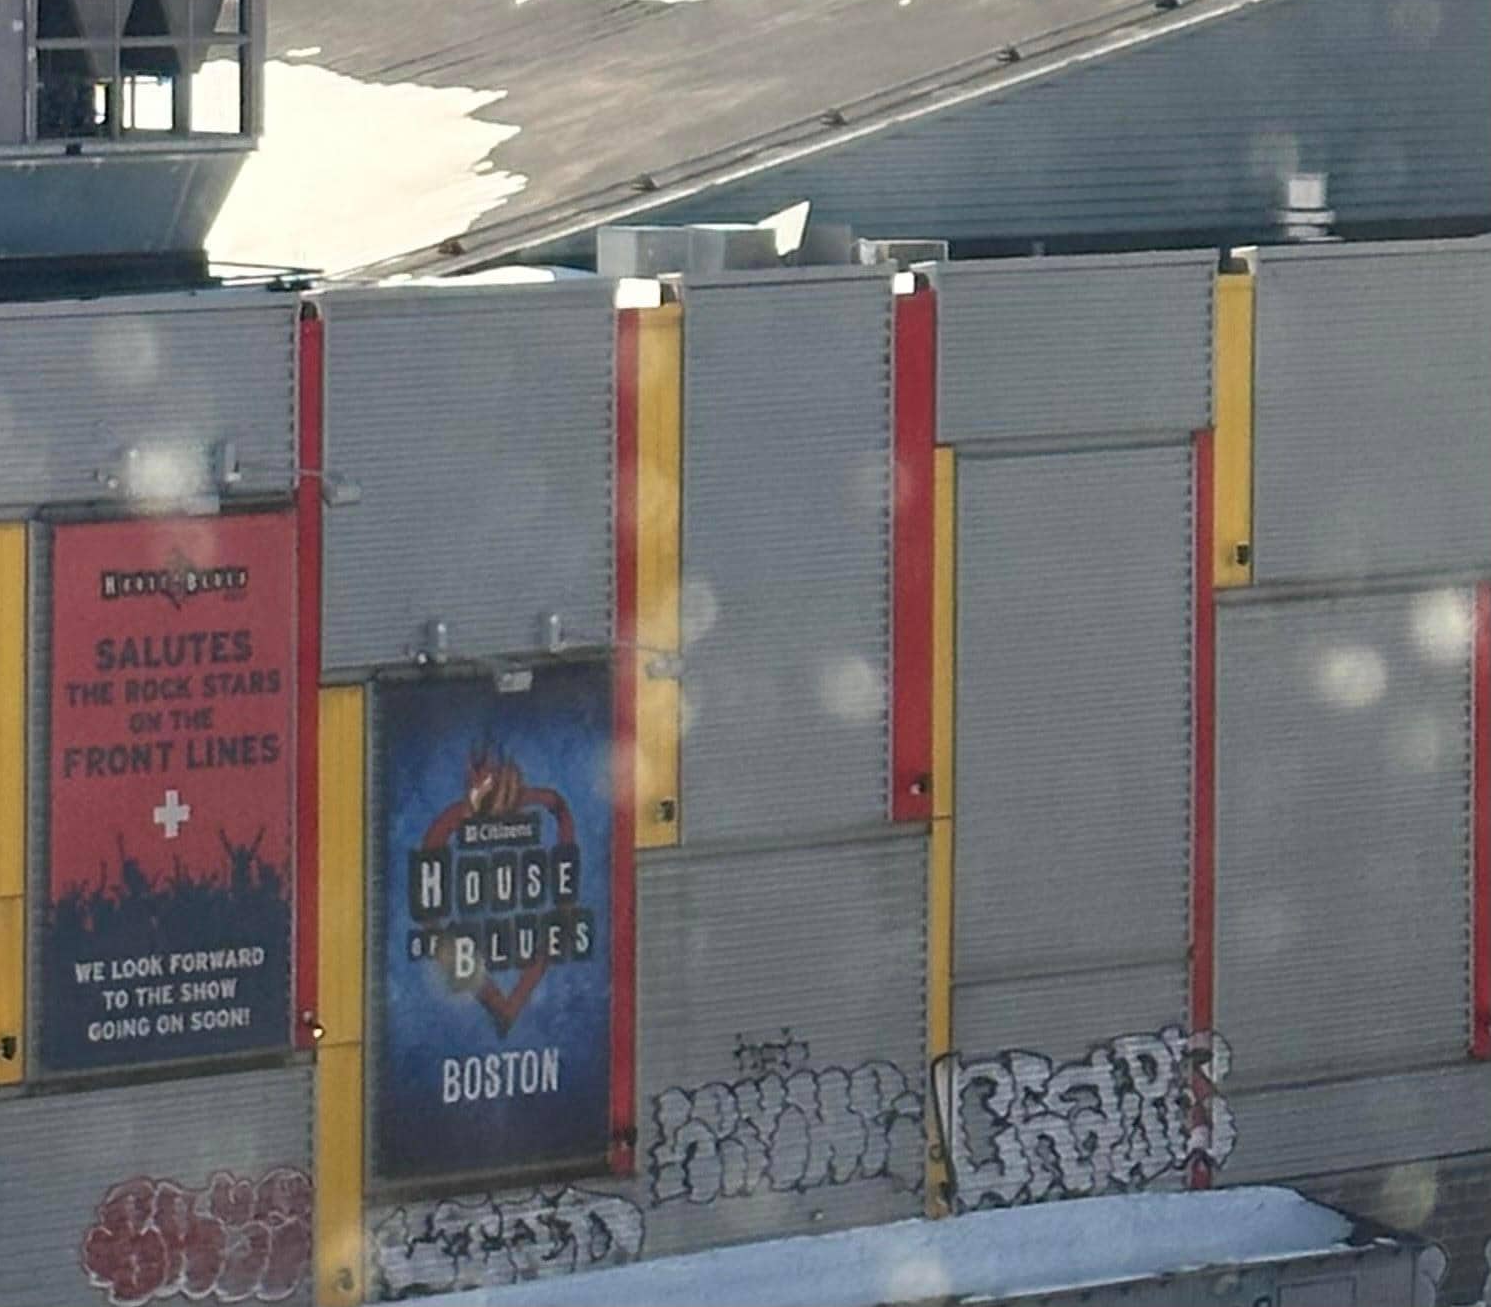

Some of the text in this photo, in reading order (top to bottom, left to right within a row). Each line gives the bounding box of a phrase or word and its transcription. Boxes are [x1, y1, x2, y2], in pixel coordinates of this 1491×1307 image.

[95, 629, 253, 671] SALUTES
[65, 669, 281, 707] THE ROCK STARS
[129, 707, 214, 734] ON THE
[63, 734, 280, 778] FRONT LINES
[420, 860, 573, 908] HOUSE
[75, 946, 266, 984] WE LOOK FORWARD
[455, 921, 590, 979] BLUES
[103, 978, 238, 1010] TO THE SHOW
[87, 1006, 252, 1042] GOING ON SOON!
[442, 1048, 560, 1104] BOSTON
